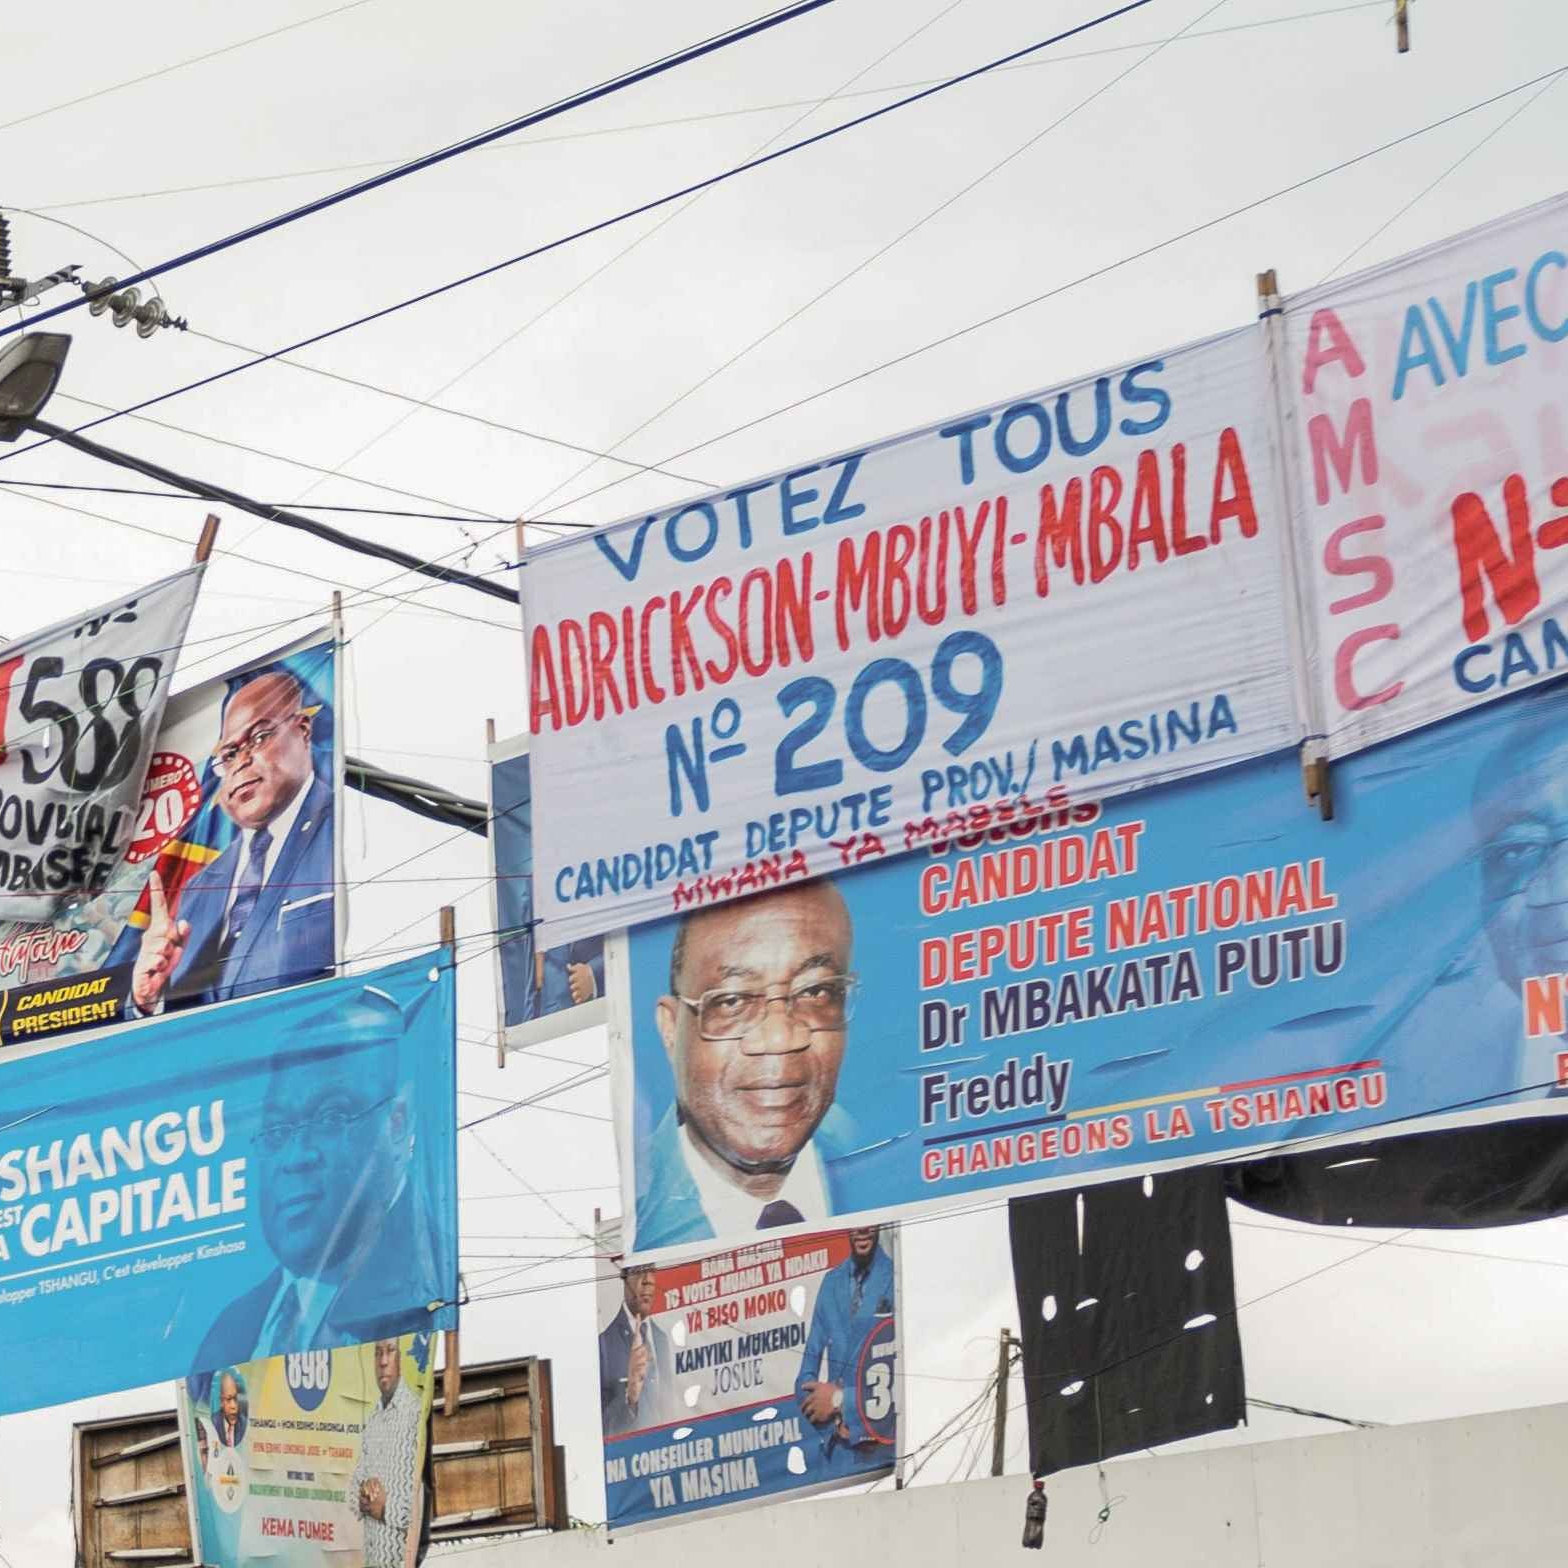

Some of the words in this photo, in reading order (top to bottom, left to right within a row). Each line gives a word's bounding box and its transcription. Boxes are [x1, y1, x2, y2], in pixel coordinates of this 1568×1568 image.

[595, 452, 867, 583] VOTEZ
[940, 359, 1175, 486] TOUS
[527, 427, 1261, 736] ADRICKSON-MBUYI-MBALA
[19, 657, 163, 792] 588
[773, 630, 1004, 799] 209
[554, 831, 718, 905] CANDIDAT
[746, 782, 893, 852] DEPUTE
[919, 819, 1147, 917] CANDIDAT
[919, 906, 1094, 988] DEPUTE
[1107, 857, 1337, 951] NATIONAL
[920, 1000, 968, 1052] Dr
[981, 947, 1202, 1039] MBAKATA
[1218, 921, 1346, 996] PUTU
[921, 1054, 1072, 1125] Freddy
[20, 1157, 247, 1258] CAPITALE
[675, 1343, 732, 1375] KANYIKI
[738, 1323, 805, 1357] MUKENDI
[262, 1517, 295, 1537] KEMA
[298, 1520, 334, 1542] FUMBE
